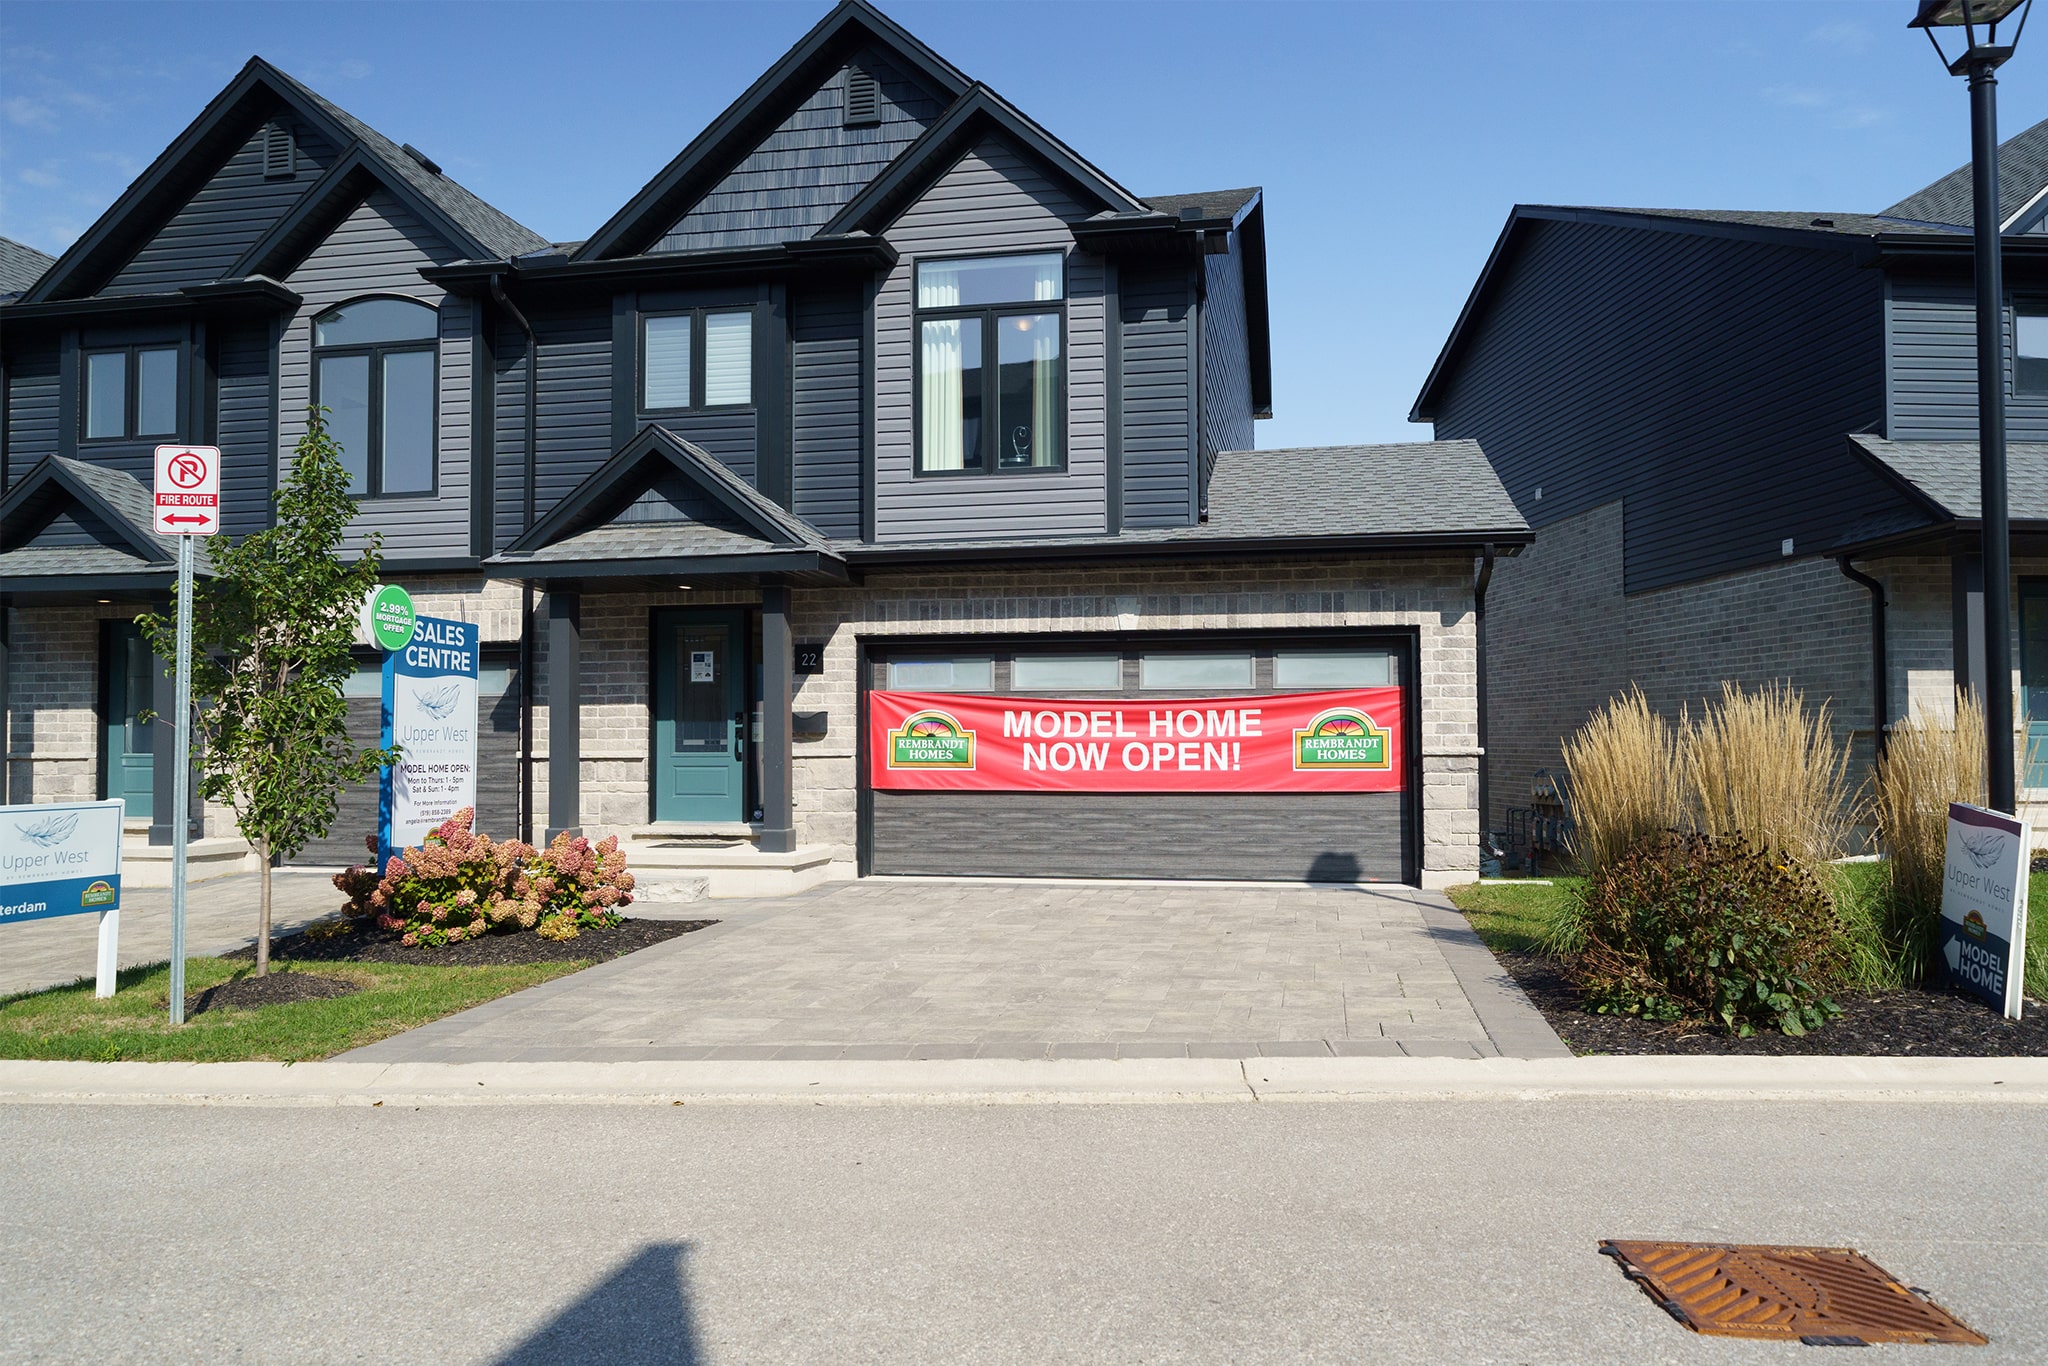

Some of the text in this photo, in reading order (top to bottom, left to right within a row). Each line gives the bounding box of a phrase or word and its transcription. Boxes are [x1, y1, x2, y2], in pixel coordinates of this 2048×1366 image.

[160, 495, 213, 505] FIRE ROUTE
[380, 602, 408, 616] 2.99%
[376, 613, 412, 626] MORTGAGE
[383, 623, 404, 634] OFFER
[413, 620, 464, 647] SALES
[405, 645, 471, 671] CENTRE
[802, 653, 817, 666] 22
[1003, 708, 1263, 738] MODEL HOME
[403, 725, 469, 745] Upper West
[898, 739, 965, 750] REMBRANDT
[1305, 738, 1379, 750] REMBRANDT
[909, 749, 954, 760] HOMES
[1023, 742, 1241, 772] NOW OPEN!
[1317, 749, 1367, 760] HOMES
[400, 764, 471, 773] MODEL HOME OPEN:
[412, 785, 422, 793] Sat
[3, 850, 89, 872] Upper West
[1948, 863, 2011, 903] Upper West
[1961, 940, 2004, 975] MODEL
[1960, 957, 2004, 995] HOME
